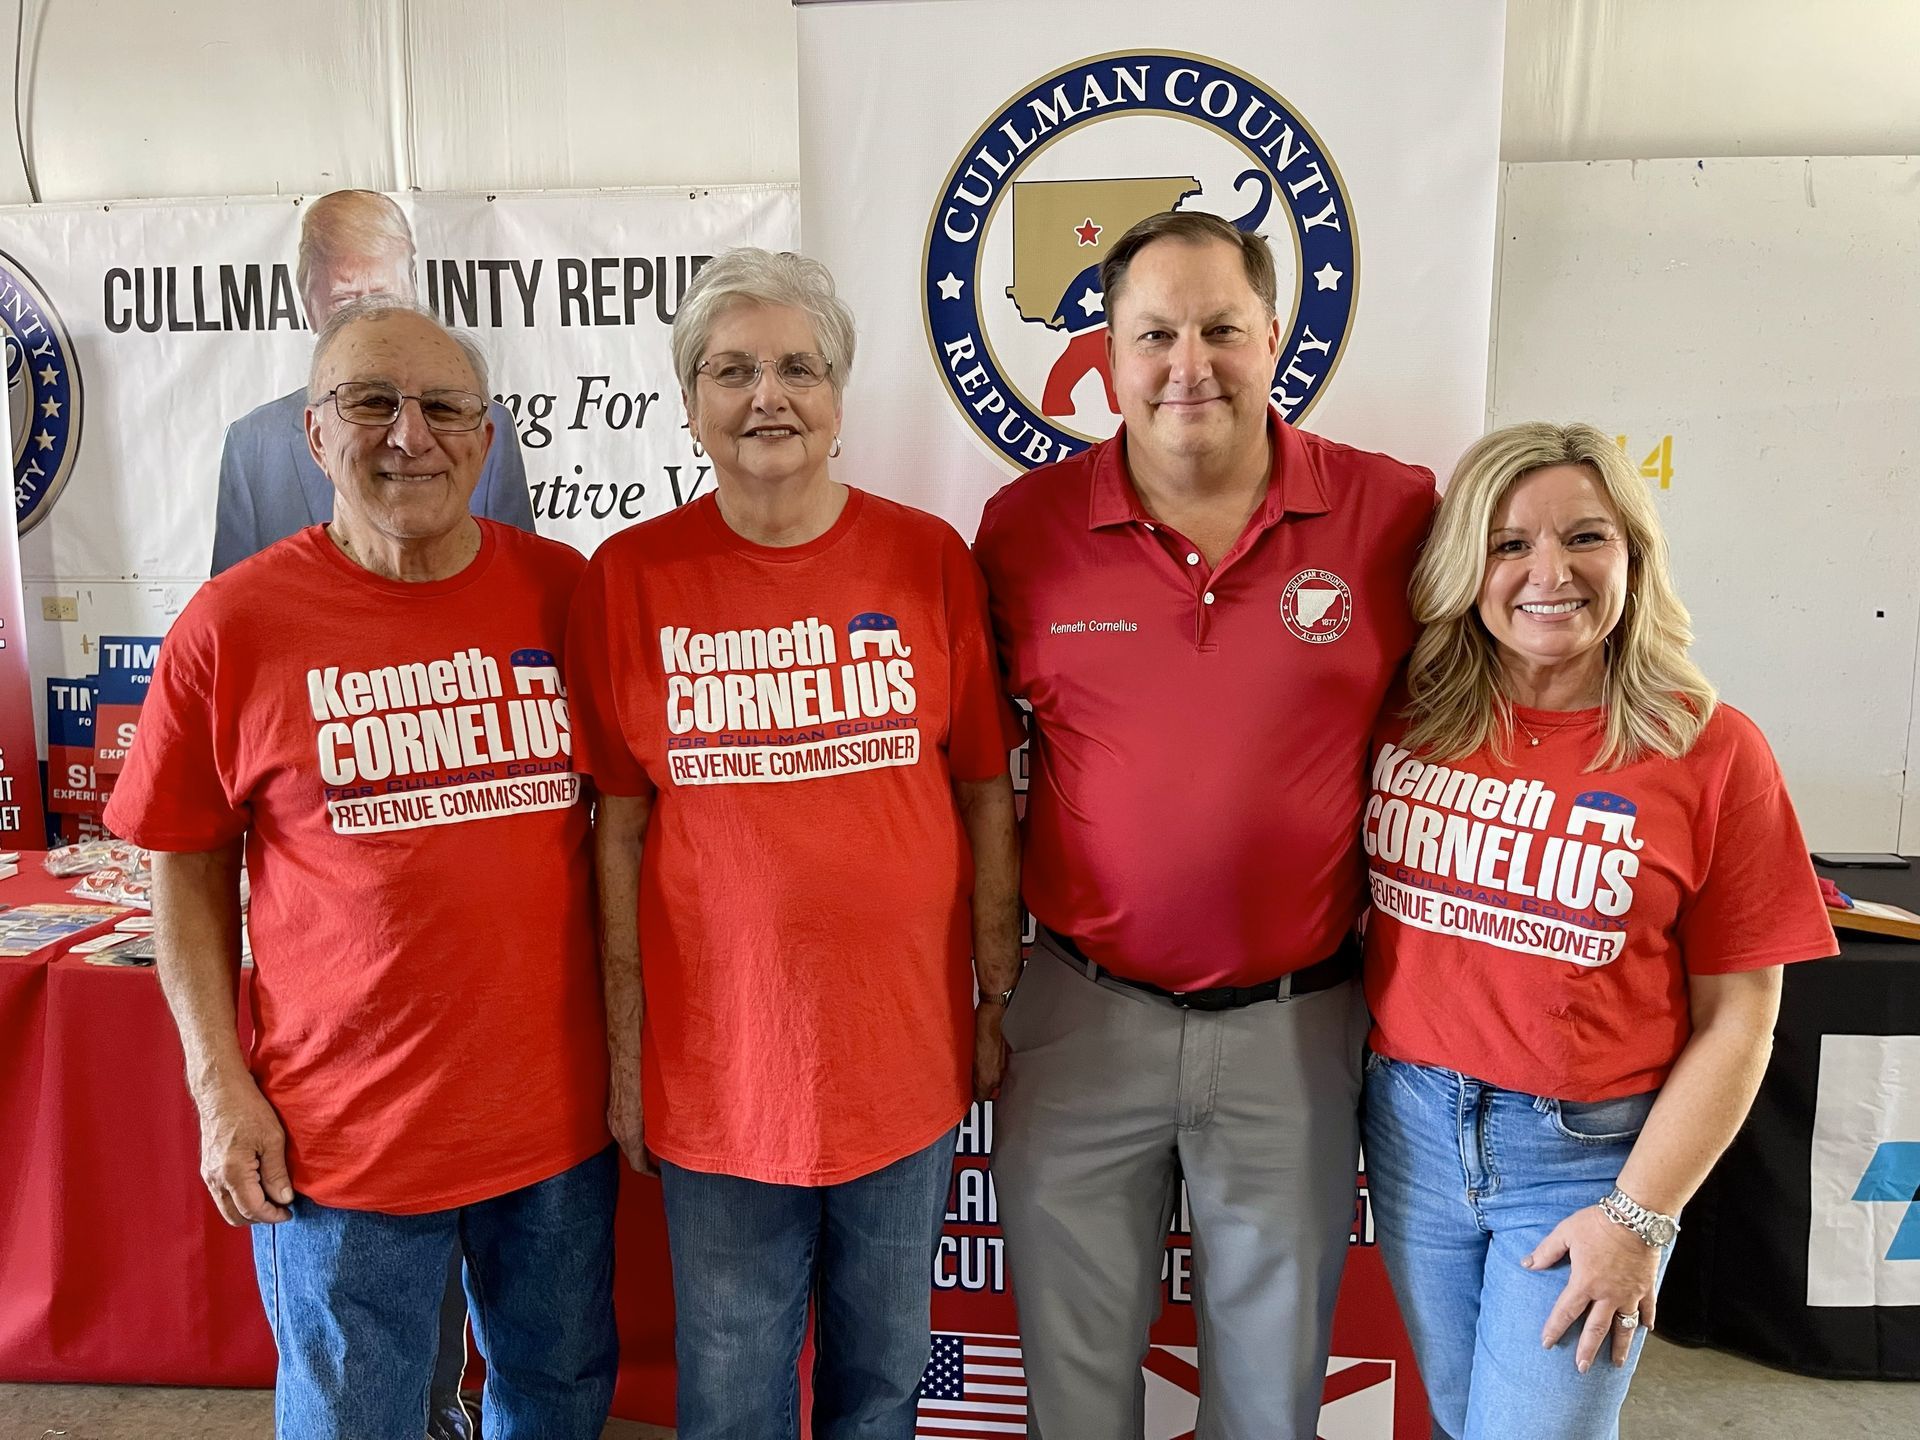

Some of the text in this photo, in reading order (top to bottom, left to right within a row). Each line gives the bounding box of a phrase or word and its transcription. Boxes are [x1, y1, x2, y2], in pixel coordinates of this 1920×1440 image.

[944, 65, 1341, 243] CULLMAN COUNTY
[104, 263, 308, 333] CULLMA
[568, 376, 660, 430] For
[1287, 571, 1348, 592] CULLMAN COUNTY
[660, 617, 837, 674] Kenneth
[1050, 619, 1138, 635] Kenneth Cornelius
[1300, 631, 1339, 642] ALABAMA
[1321, 618, 1338, 626] 1877
[307, 648, 503, 721] Kenneth
[667, 659, 917, 735] CORNELIUS
[668, 717, 919, 749] FOR CULLMAN COUNTY
[671, 735, 915, 780] REVENUE COMMISSIONER
[324, 786, 374, 800] FOR
[387, 769, 495, 793] CULLMAN
[335, 778, 577, 828] REVENUE COMMISSIONER
[1372, 742, 1557, 830] Kenneth
[1362, 793, 1640, 917] CORNELIUS
[1370, 874, 1616, 962] REVENUE COMMISSIONER
[1396, 867, 1631, 931] CULLMAN COUNTY
